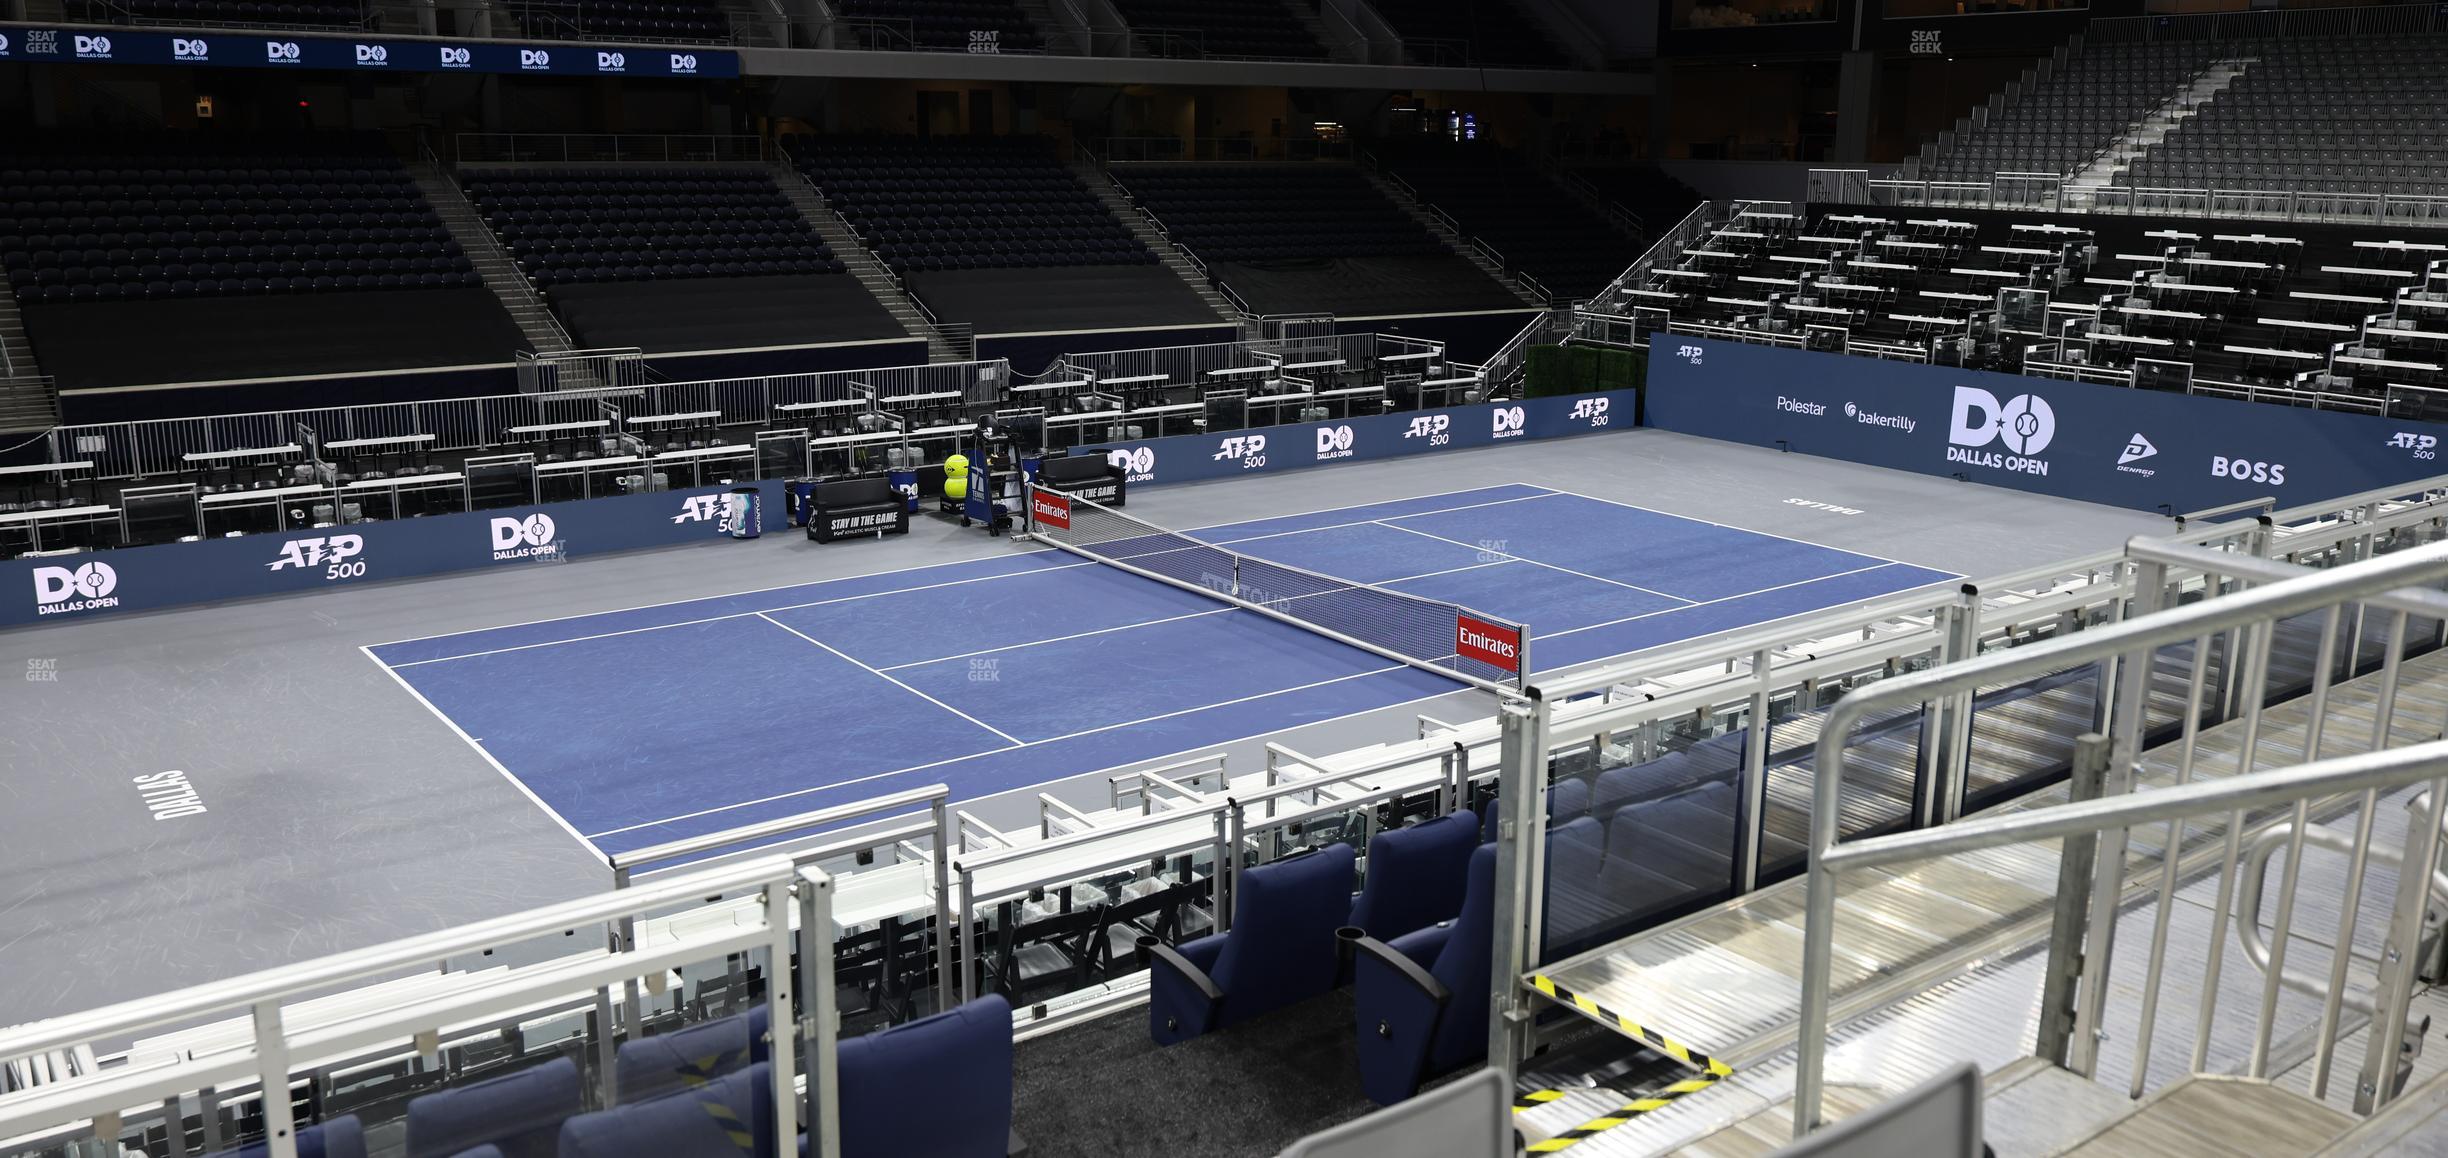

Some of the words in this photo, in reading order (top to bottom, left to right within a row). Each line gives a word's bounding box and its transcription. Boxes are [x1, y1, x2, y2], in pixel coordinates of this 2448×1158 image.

[1676, 345, 1702, 358] ATP
[1569, 397, 1609, 419] ATP
[1777, 396, 1826, 416] Polestar
[1403, 414, 1449, 439] ATP
[1591, 413, 1608, 427] 500
[1858, 410, 1916, 433] bakertilly
[1430, 434, 1449, 446] 500
[1493, 430, 1510, 439] DALLAS
[1511, 428, 1524, 437] OPEN
[2385, 432, 2437, 450] ATP
[1212, 434, 1266, 460] ATP
[1317, 452, 1337, 460] DALLAS
[1337, 450, 1352, 458] OPEN
[2413, 450, 2435, 460] 500
[1244, 455, 1266, 468] 500
[1947, 446, 2002, 468] DALLAS
[2005, 456, 2048, 476] OPEN
[1137, 473, 1154, 481] OPEN
[2117, 465, 2155, 476] DENAGO
[2212, 456, 2285, 485] BOSS
[1085, 488, 1097, 498] THE
[1097, 485, 1116, 497] GAME
[1035, 500, 1068, 520] Emirates
[1784, 498, 1864, 515] DALLAS
[831, 518, 850, 530] STAY
[850, 516, 860, 527] IN
[860, 515, 875, 526] THE
[875, 512, 898, 524] GAME
[264, 534, 363, 571] ATP
[494, 548, 529, 560] DALLAS
[530, 545, 556, 555] OPEN
[326, 562, 365, 580] 500
[38, 601, 84, 615] DALLAS
[86, 597, 118, 609] OPEN
[1459, 626, 1514, 658] Emirates
[132, 770, 208, 820] DALLAS
